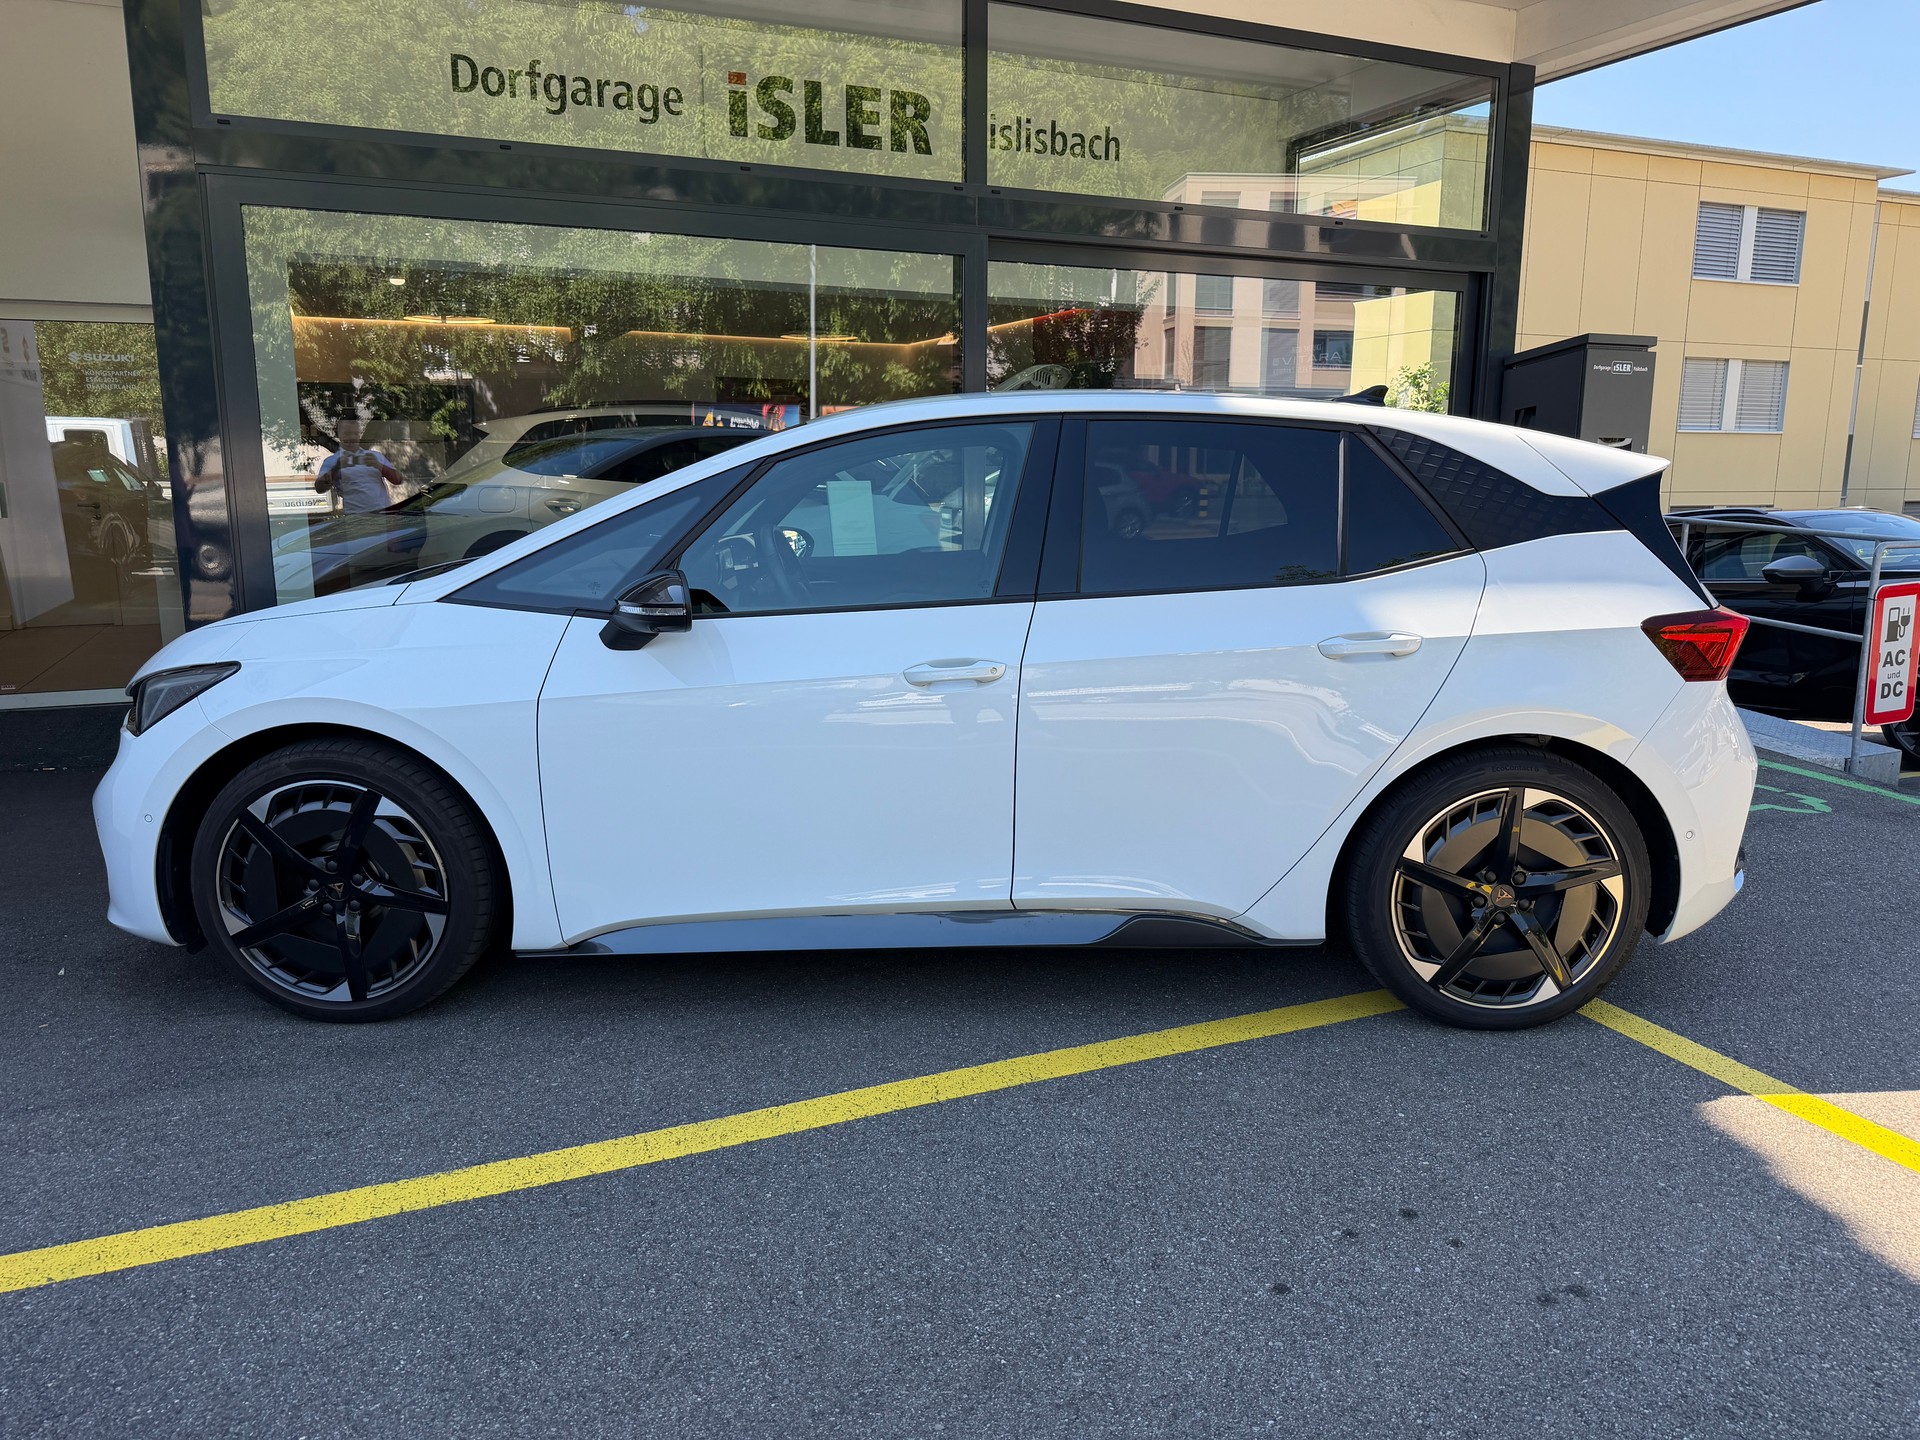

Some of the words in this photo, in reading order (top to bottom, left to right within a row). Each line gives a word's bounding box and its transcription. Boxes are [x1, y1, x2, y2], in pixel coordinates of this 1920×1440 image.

[450, 53, 684, 125] Dorfgarage
[727, 70, 933, 156] iSLER
[989, 113, 1120, 162] islisbach
[83, 353, 135, 362] SUZUKI
[1613, 363, 1631, 371] iSLER
[1882, 649, 1906, 668] AC
[1887, 670, 1901, 679] und
[1880, 681, 1904, 699] DC
